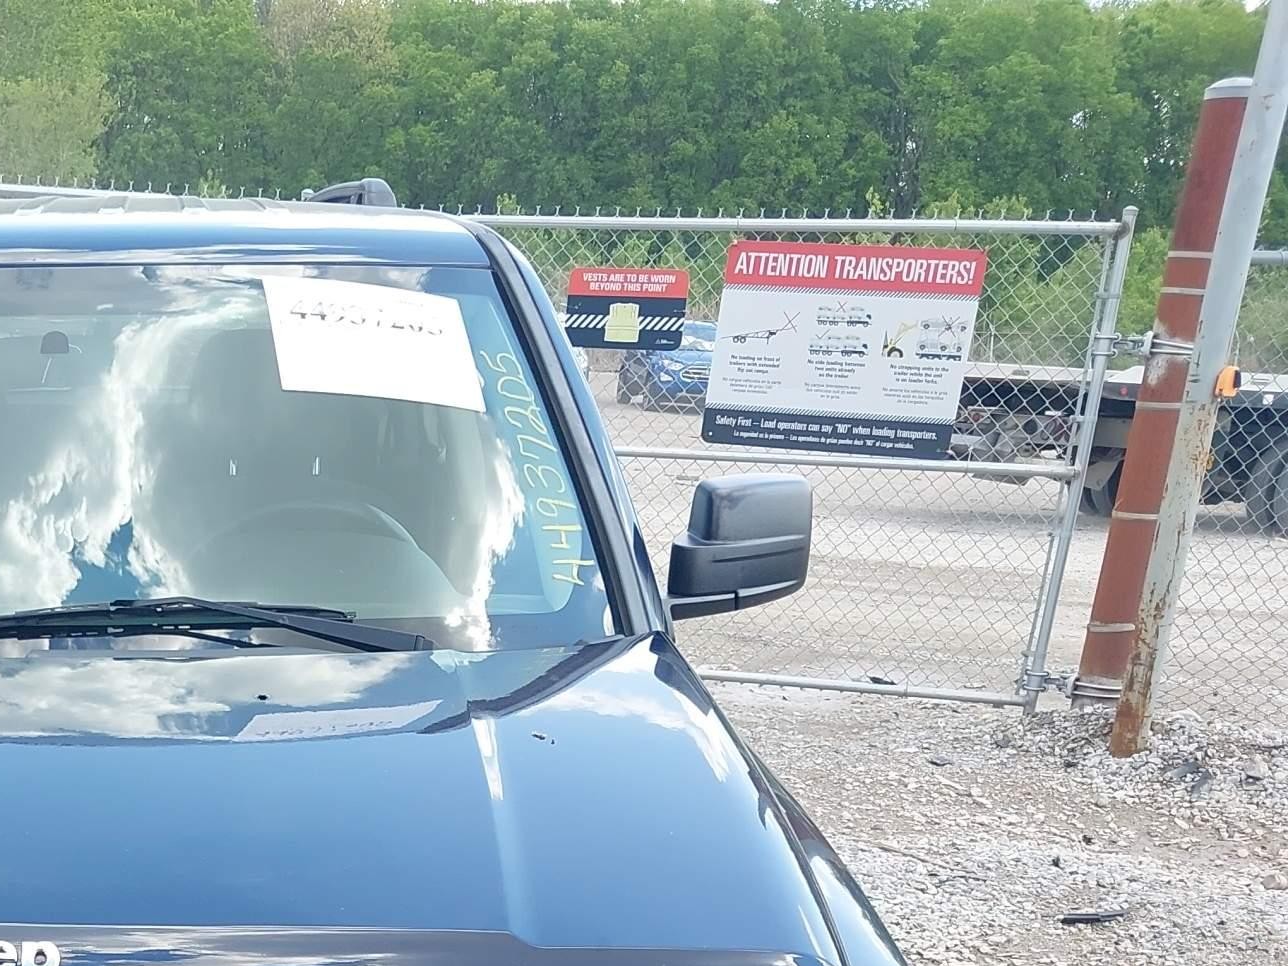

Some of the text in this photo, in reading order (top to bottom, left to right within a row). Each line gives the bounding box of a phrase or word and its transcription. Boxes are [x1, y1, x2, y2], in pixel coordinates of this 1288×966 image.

[734, 251, 977, 285] ATTENTION TRANSPORTERS!
[583, 273, 676, 284] VESTS ARE TO BE WORN
[590, 282, 668, 293] BEYOND THIS POINT
[715, 415, 736, 427] Safety
[737, 416, 752, 427] First
[760, 418, 776, 428] Load
[777, 421, 807, 431] operators
[808, 424, 820, 432] can
[821, 425, 833, 434] say
[852, 426, 870, 435] when
[872, 426, 895, 438] loading
[896, 429, 937, 441] transporters.
